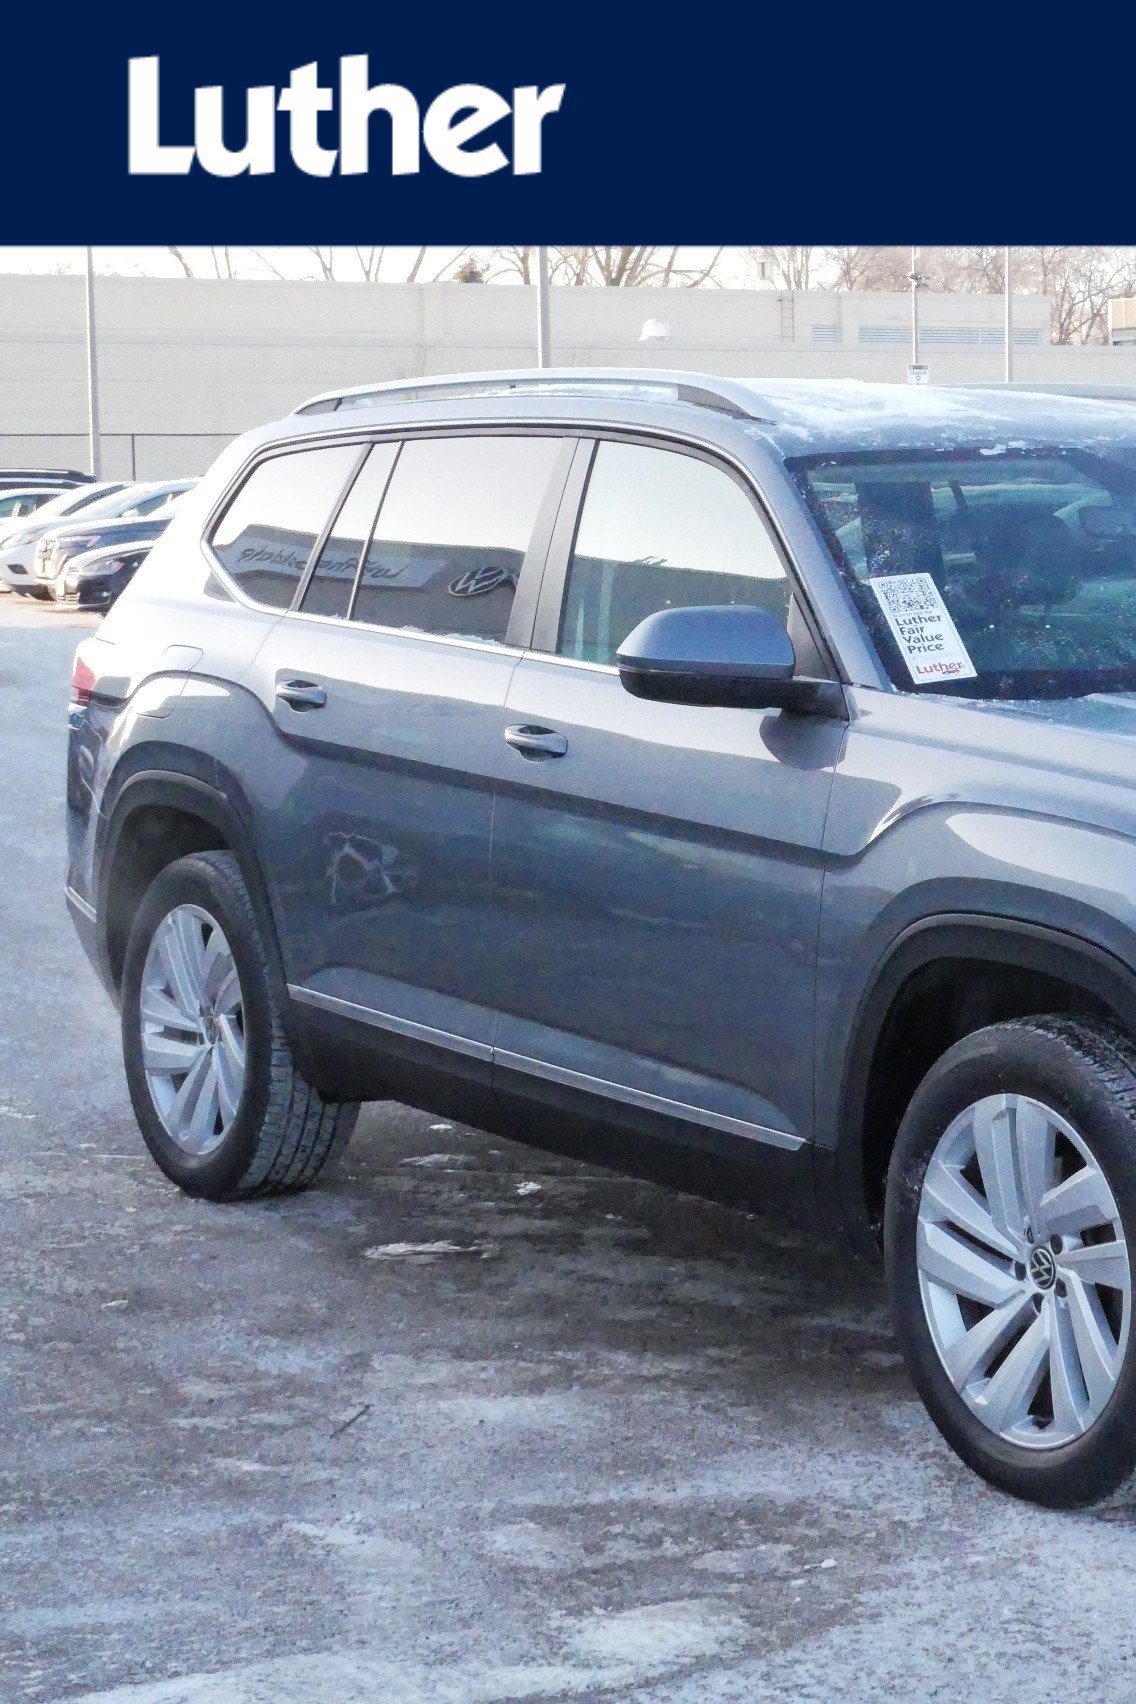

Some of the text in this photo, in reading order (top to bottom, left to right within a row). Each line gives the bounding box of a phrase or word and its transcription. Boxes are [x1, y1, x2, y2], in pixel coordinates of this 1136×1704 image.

[895, 614, 942, 627] Luther
[899, 626, 925, 636] Fair
[902, 633, 944, 644] Value
[907, 643, 945, 654] Price
[915, 661, 963, 674] Luther
